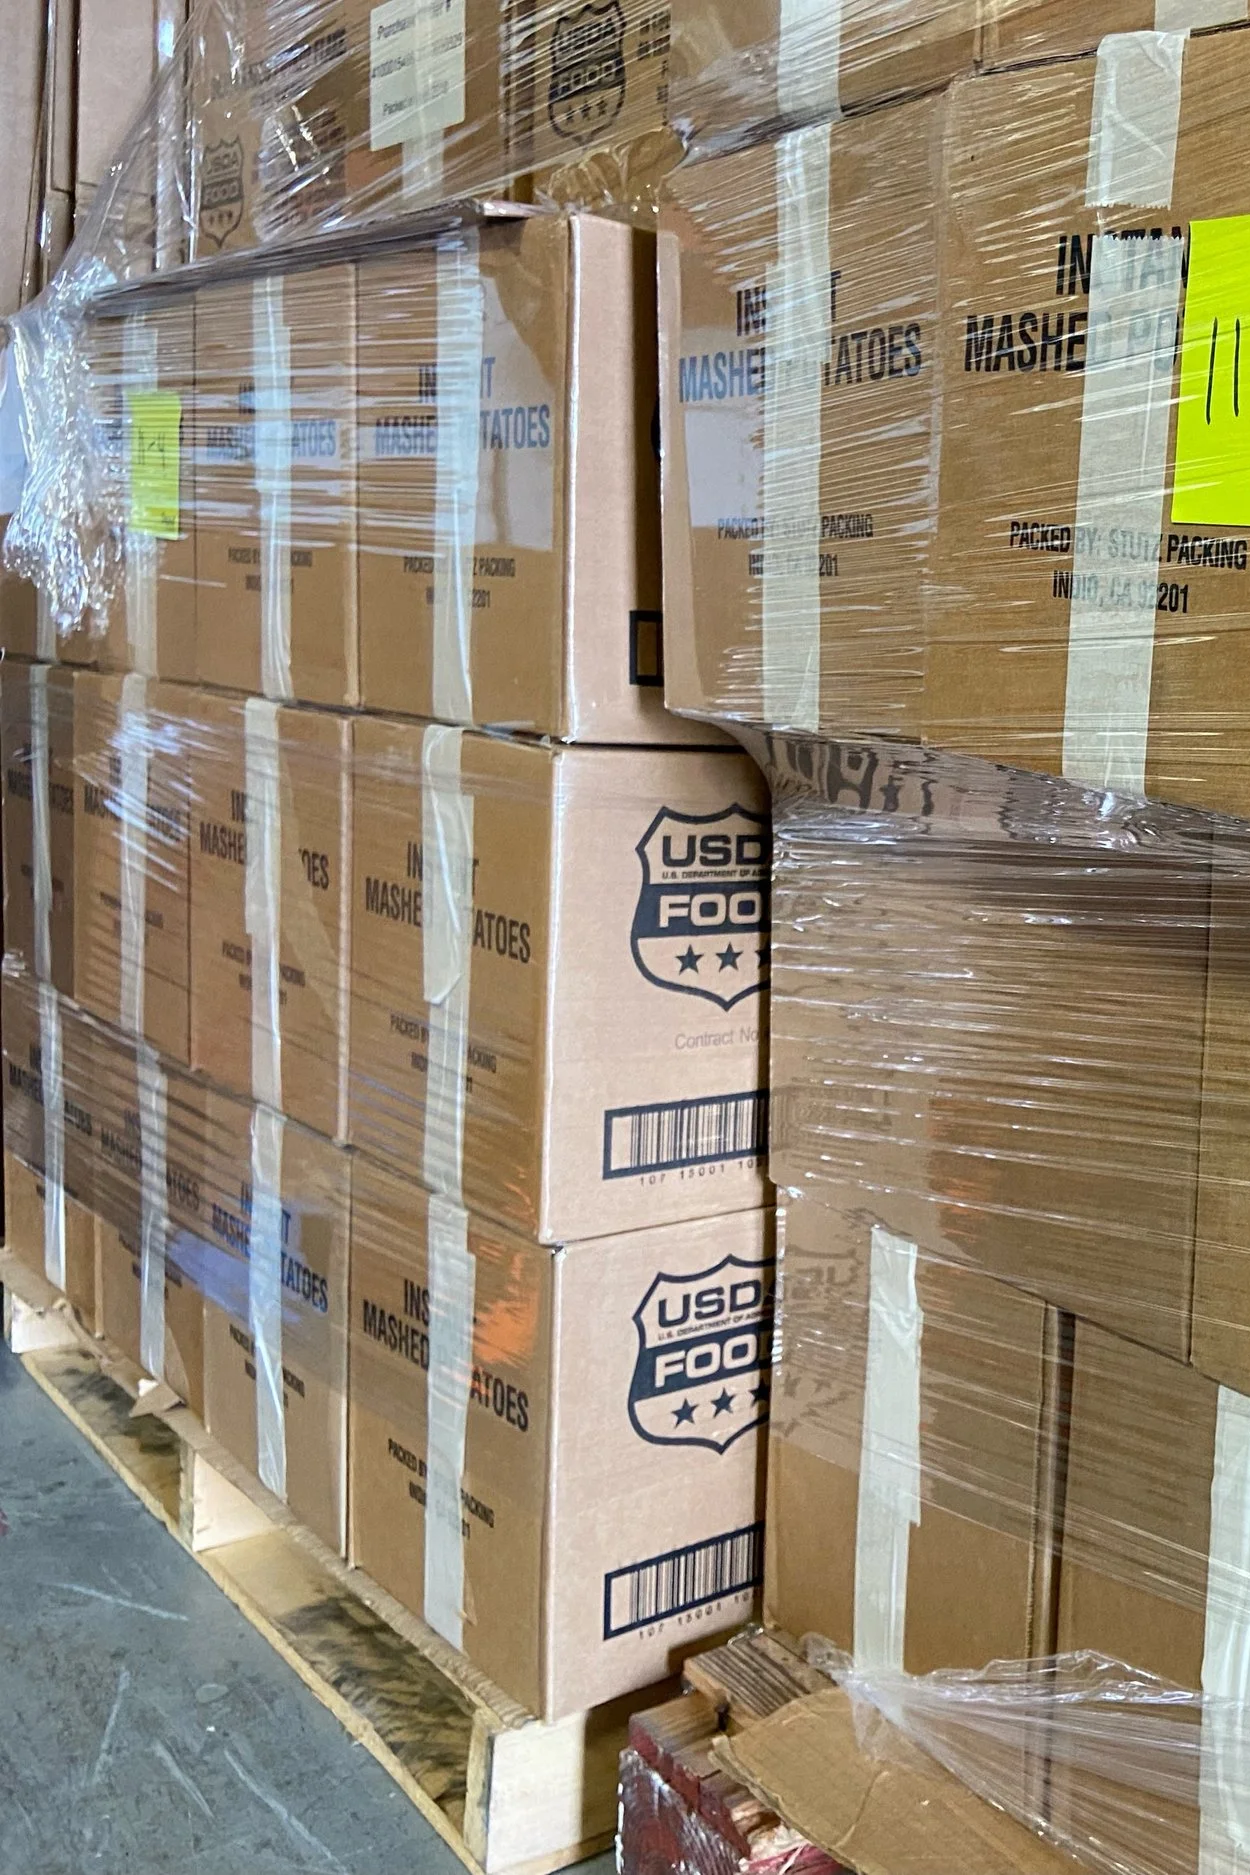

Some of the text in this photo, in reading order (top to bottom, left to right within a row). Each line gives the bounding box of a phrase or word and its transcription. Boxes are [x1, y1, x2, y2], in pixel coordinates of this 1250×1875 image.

[479, 404, 550, 449] TATOES
[1009, 521, 1071, 553] PACKED
[1166, 533, 1248, 571] PACKING
[200, 821, 246, 865] MASHE
[662, 834, 768, 868] USD
[659, 891, 762, 929] FOO
[674, 1029, 735, 1050] Contract
[658, 1280, 763, 1328] USD
[655, 1333, 758, 1388] FOO
